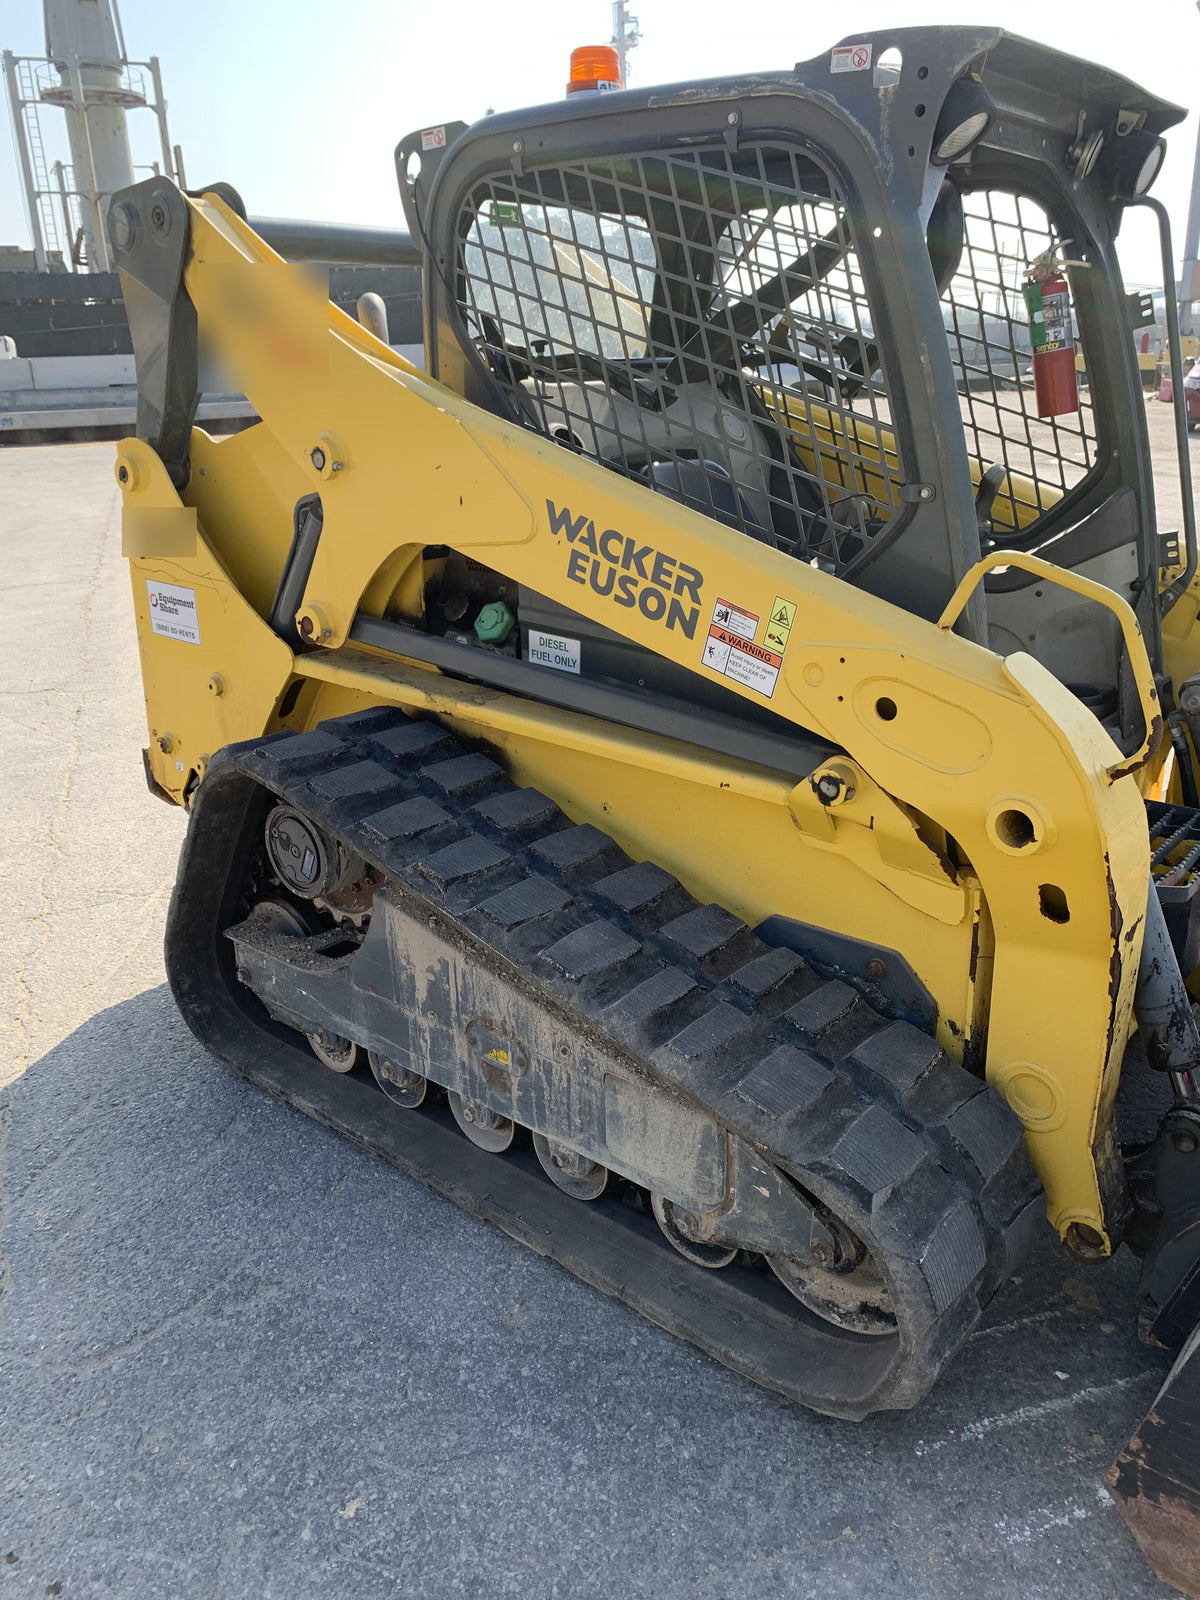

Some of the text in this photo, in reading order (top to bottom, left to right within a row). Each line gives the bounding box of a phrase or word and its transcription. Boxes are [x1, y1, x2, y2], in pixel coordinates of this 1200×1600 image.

[1036, 341, 1059, 352] sentry
[546, 499, 703, 606] WACKER
[158, 593, 195, 609] Equipment
[567, 548, 700, 640] EUSON
[159, 603, 179, 615] Share
[539, 636, 569, 652] DIESEL
[729, 637, 771, 662] WARNING
[531, 649, 577, 668] FUEL ONLY
[731, 652, 743, 662] Avoid
[743, 659, 756, 669] injury
[729, 660, 742, 668] KEEP
[742, 666, 759, 676] CLEAR
